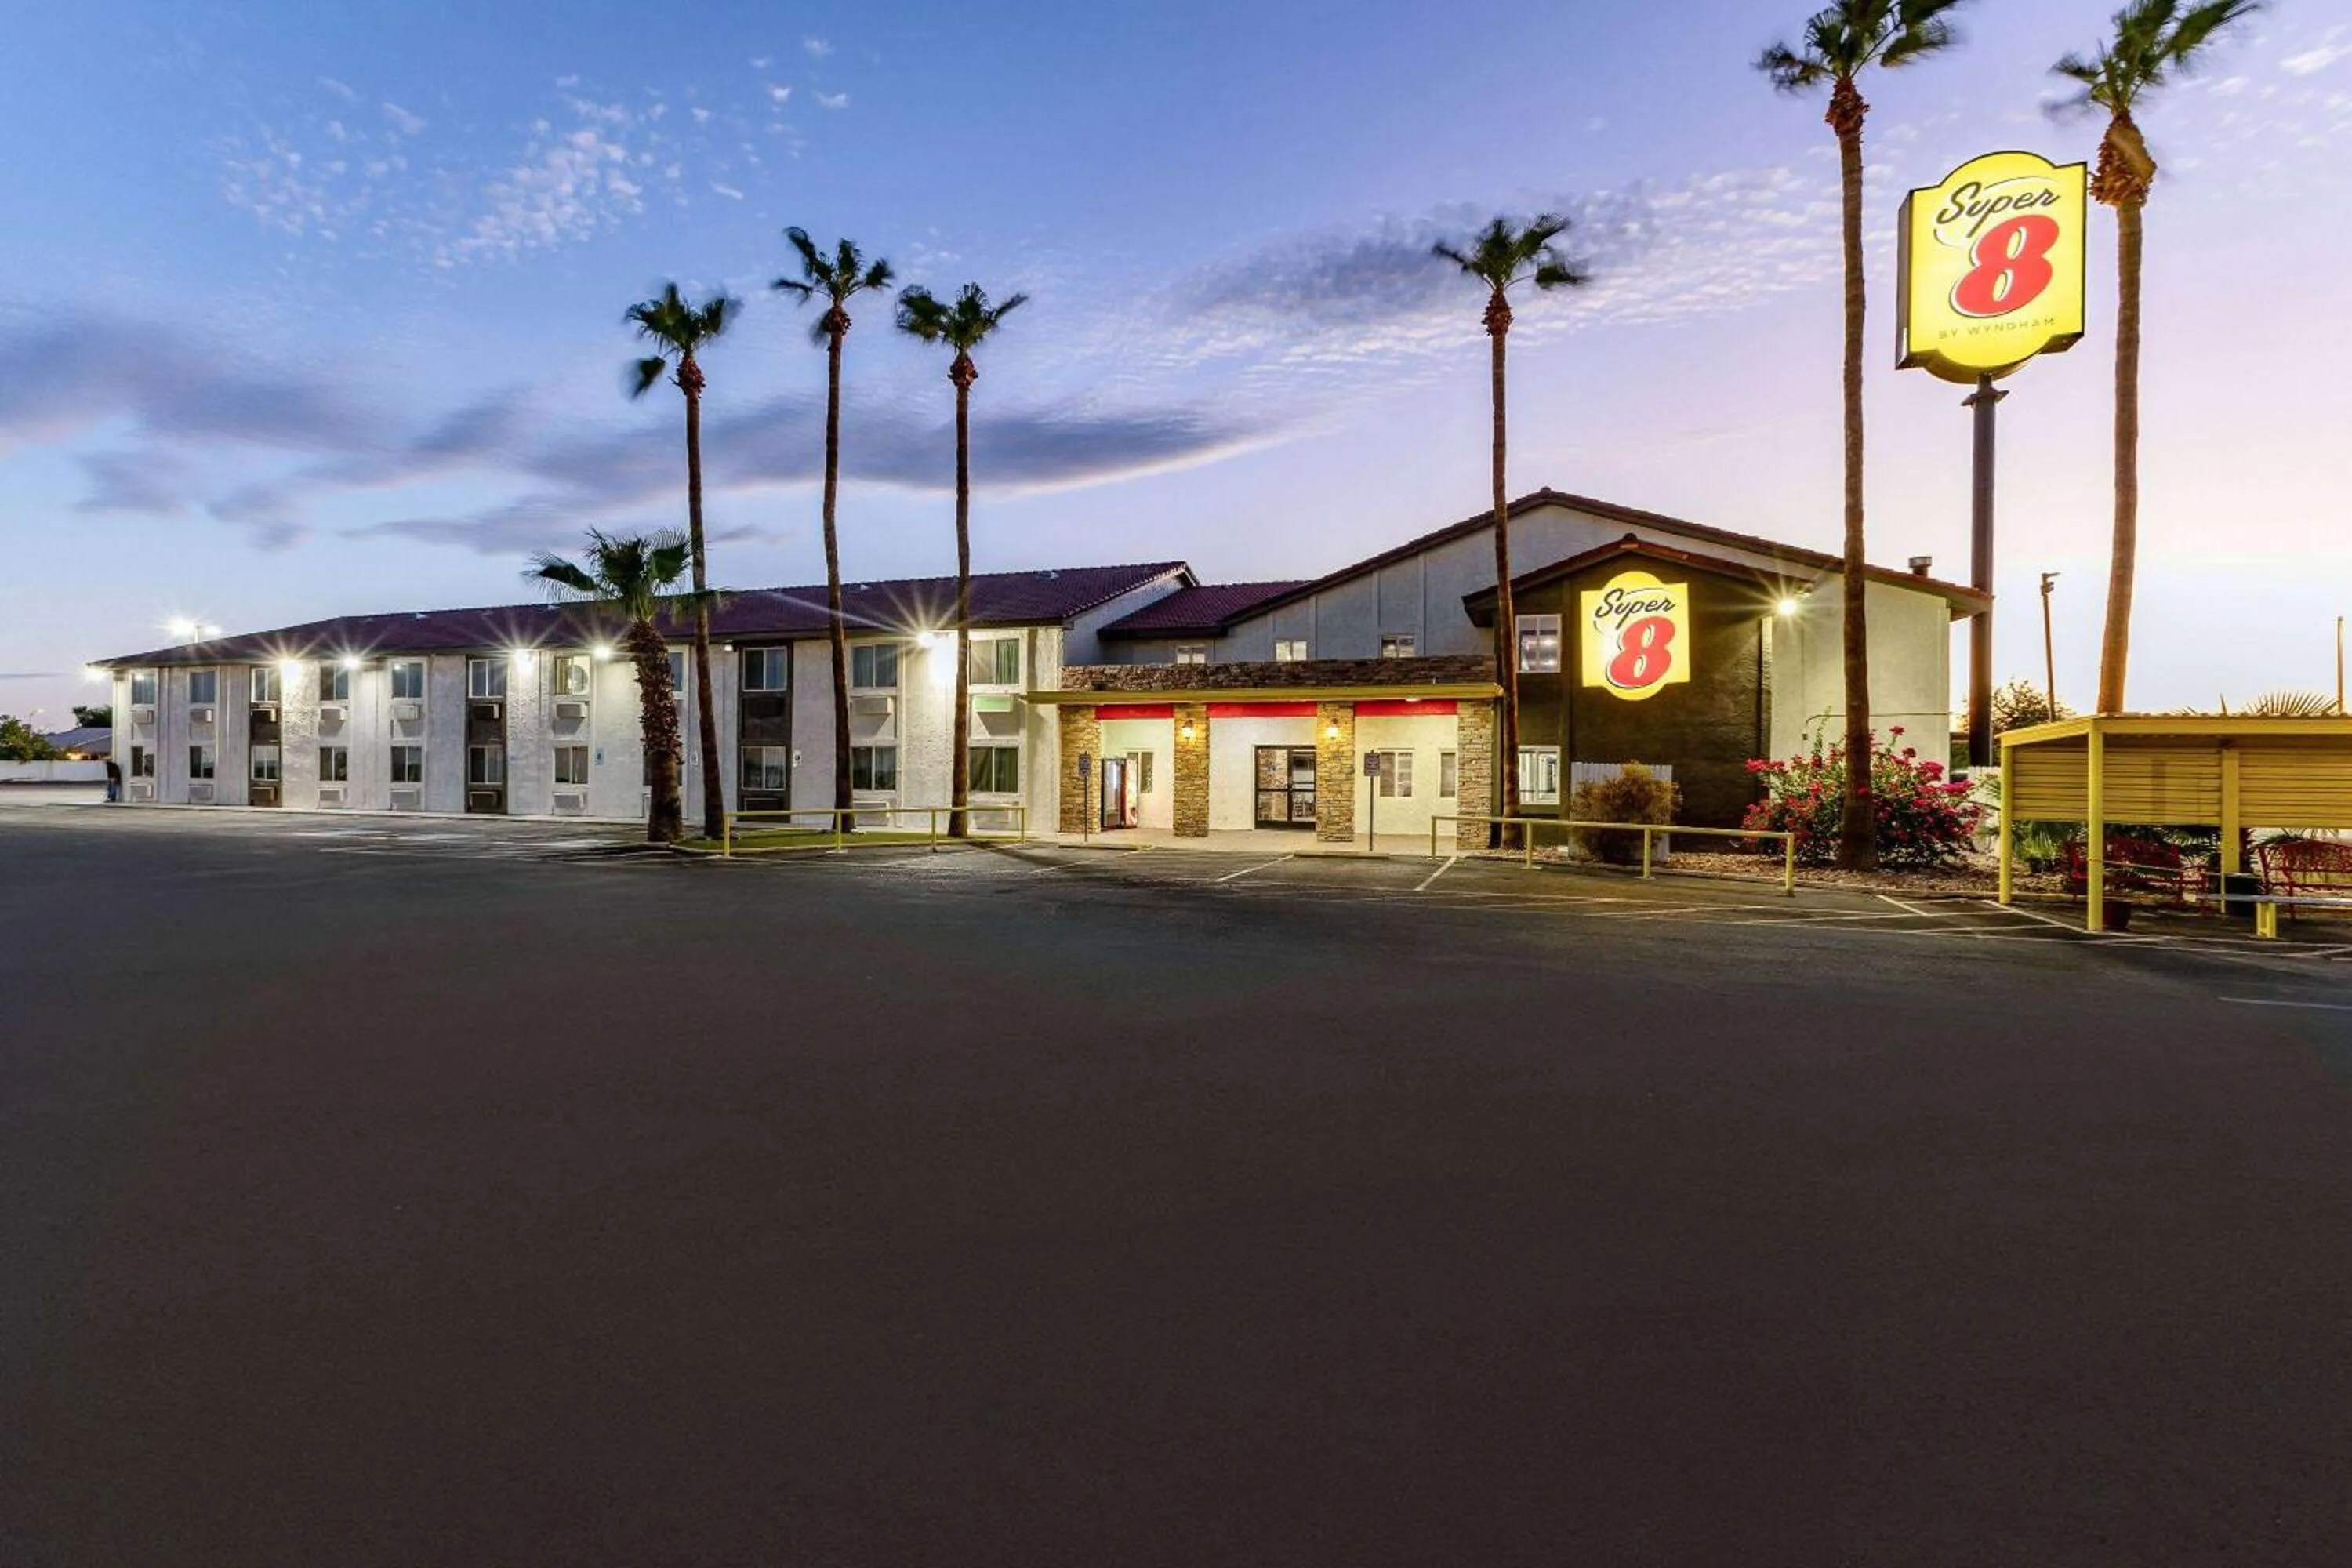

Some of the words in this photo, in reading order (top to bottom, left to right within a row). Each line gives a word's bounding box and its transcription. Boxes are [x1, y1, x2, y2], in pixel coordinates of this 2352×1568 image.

[1936, 181, 2061, 238] Super
[1951, 214, 2060, 317] 8
[1938, 328, 1958, 340] BY
[1967, 316, 2056, 336] WYNDHAM
[1595, 588, 1676, 630] Super
[1606, 615, 1675, 688] 8
